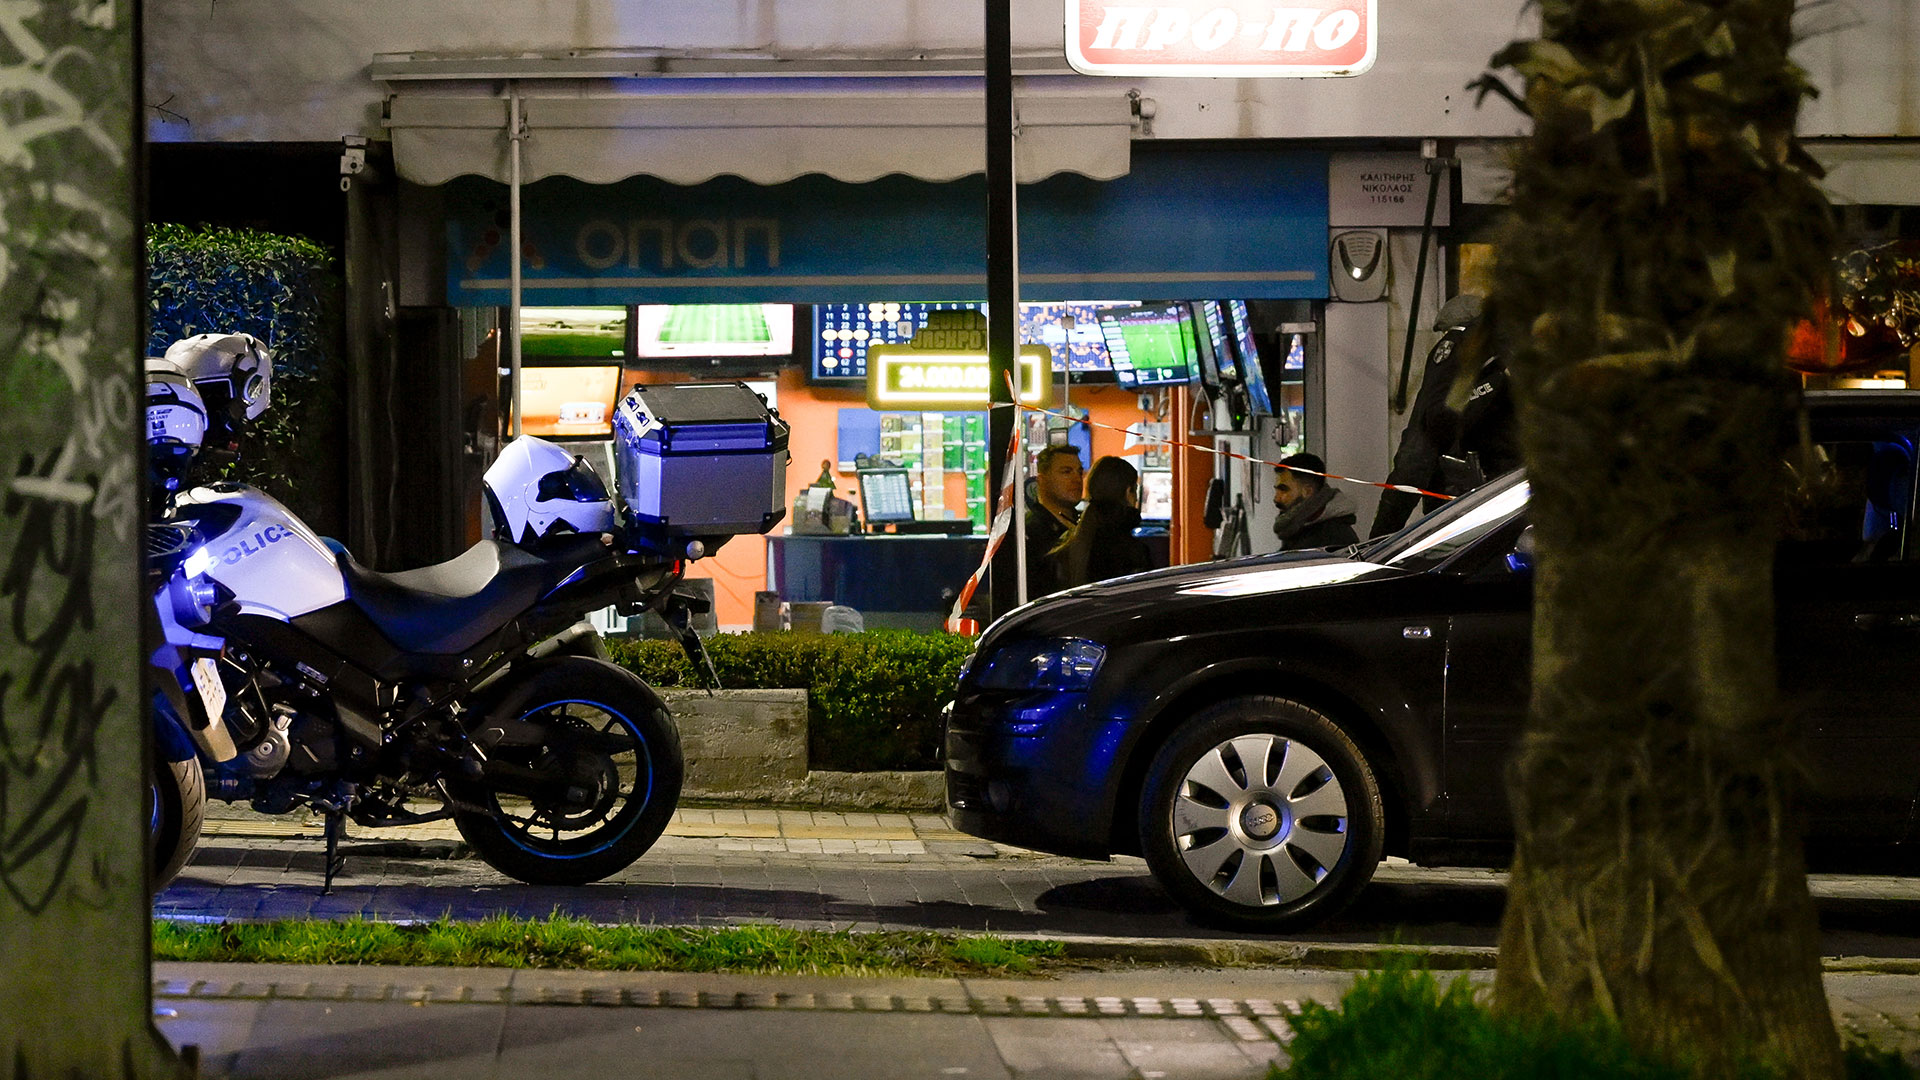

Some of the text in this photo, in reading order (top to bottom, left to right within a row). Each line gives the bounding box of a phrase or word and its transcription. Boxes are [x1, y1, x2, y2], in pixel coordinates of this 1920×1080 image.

[1362, 184, 1413, 193] ΝΙΚΟΛΑΟΣ
[842, 303, 849, 312] 2
[858, 303, 864, 312] 3
[904, 303, 911, 312] 6
[920, 303, 927, 311] 7
[935, 303, 942, 311] 8
[951, 303, 958, 311] 9
[825, 312, 834, 320] 11
[911, 329, 988, 350] JACKPO
[899, 365, 989, 388] 24.000.00
